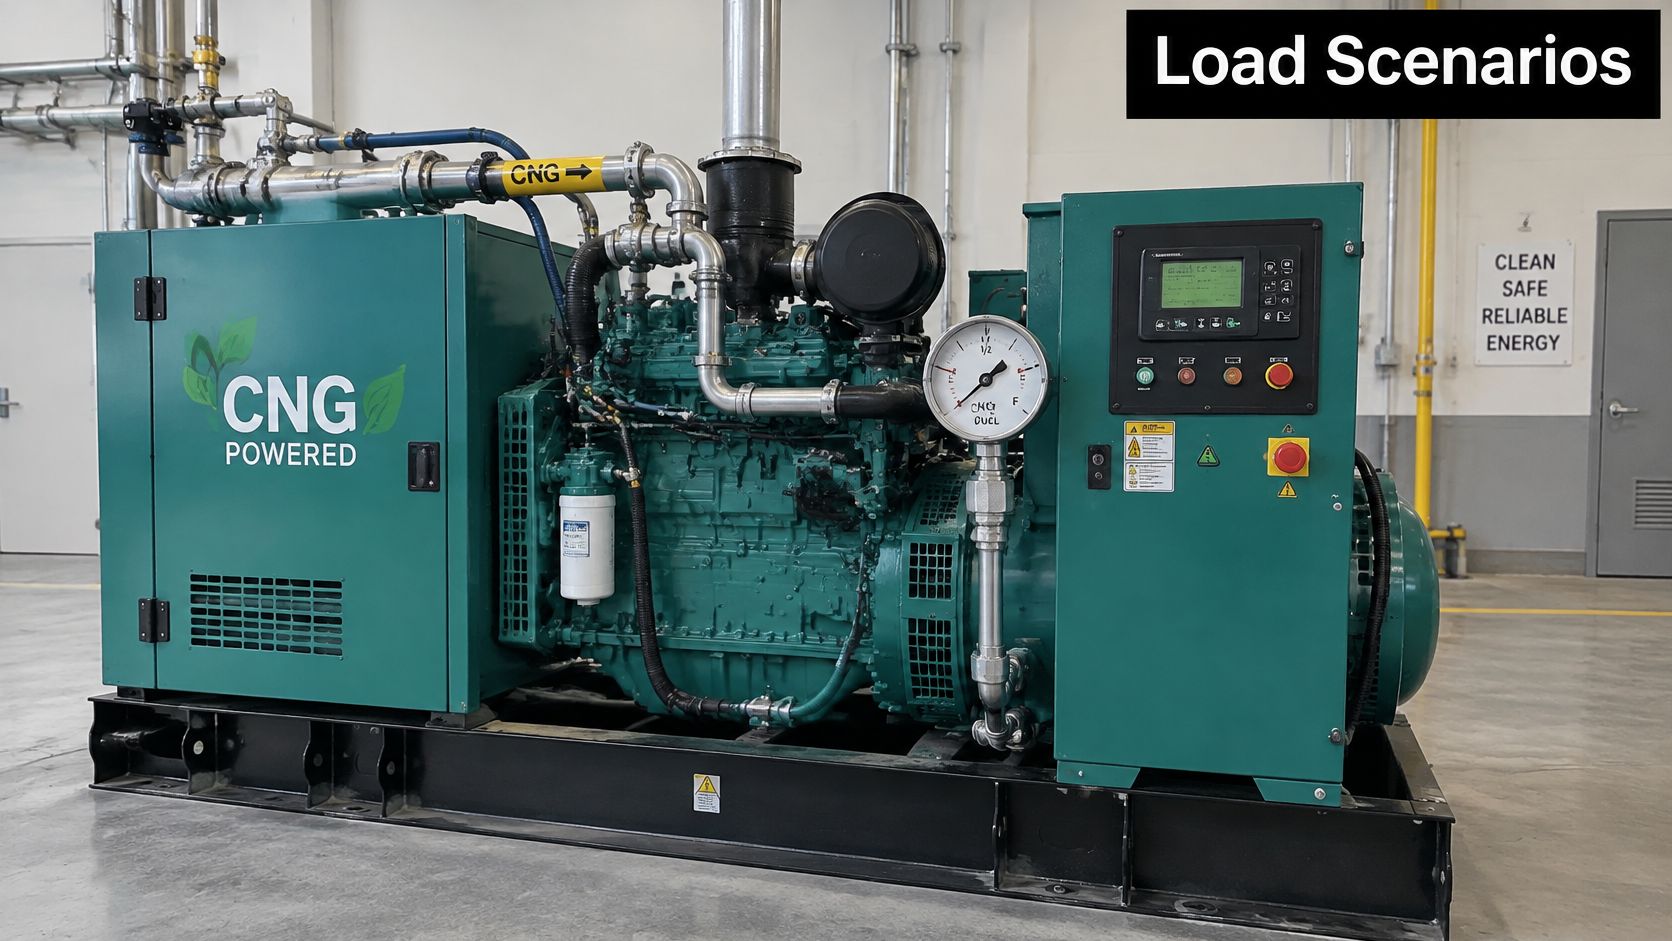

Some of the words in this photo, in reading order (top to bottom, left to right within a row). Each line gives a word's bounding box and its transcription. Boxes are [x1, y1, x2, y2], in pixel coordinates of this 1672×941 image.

[510, 163, 560, 185] CNG
[1495, 253, 1556, 270] CLEAN
[1502, 280, 1548, 297] SAFE
[1482, 307, 1568, 324] RELIABLE
[1487, 334, 1560, 351] ENERGY
[223, 374, 356, 435] CNG
[225, 441, 357, 467] POWERED
